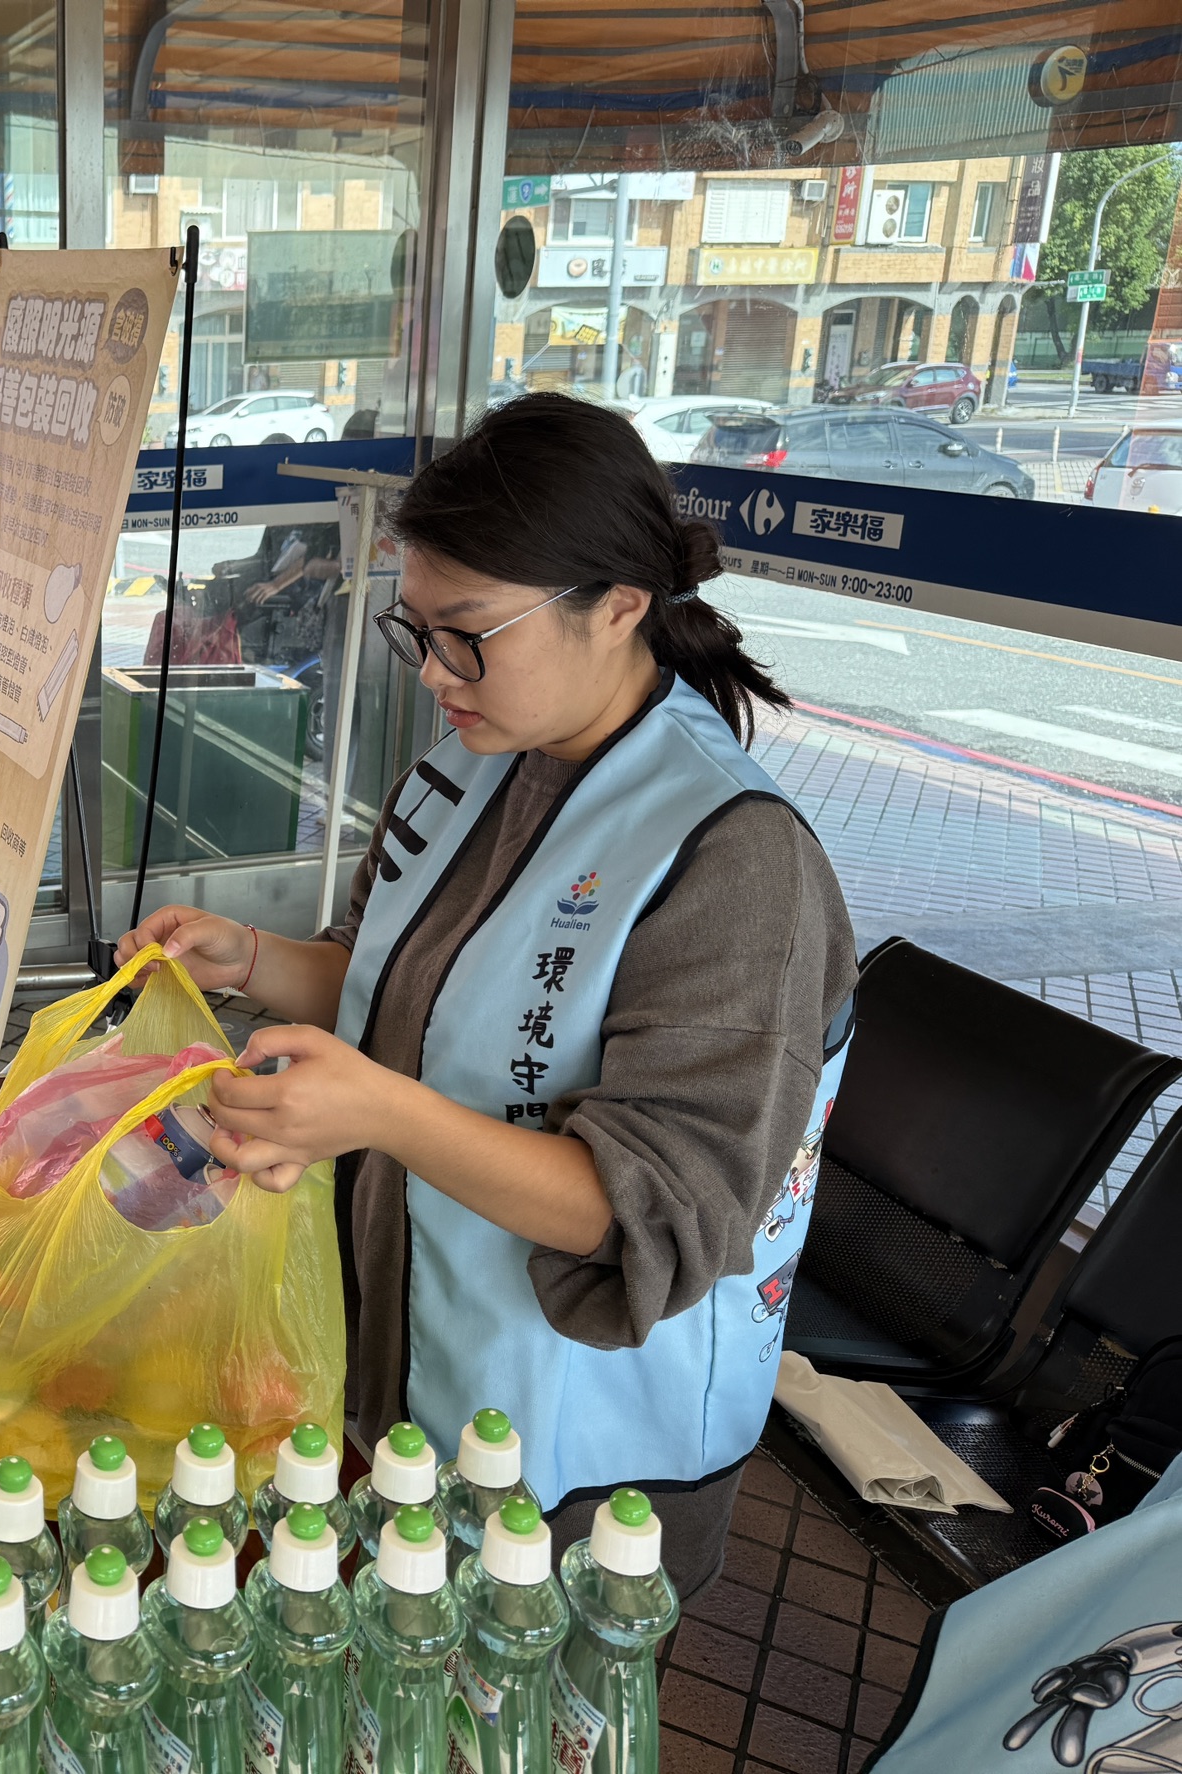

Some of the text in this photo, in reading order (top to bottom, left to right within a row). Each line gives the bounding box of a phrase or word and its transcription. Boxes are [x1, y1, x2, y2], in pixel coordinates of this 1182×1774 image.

[2, 297, 105, 363] 廢照明光源
[131, 517, 170, 528] MON~SUN
[181, 511, 238, 526] :00~23:00
[674, 487, 731, 520] efour
[810, 508, 885, 543] 家樂福
[721, 556, 742, 569] ours
[797, 568, 837, 588] MON~SUN
[841, 574, 913, 603] 9:00~23:00
[549, 916, 591, 932] Hualien
[505, 946, 576, 1132] 環境守門
[1031, 1503, 1069, 1537] Kuromi
